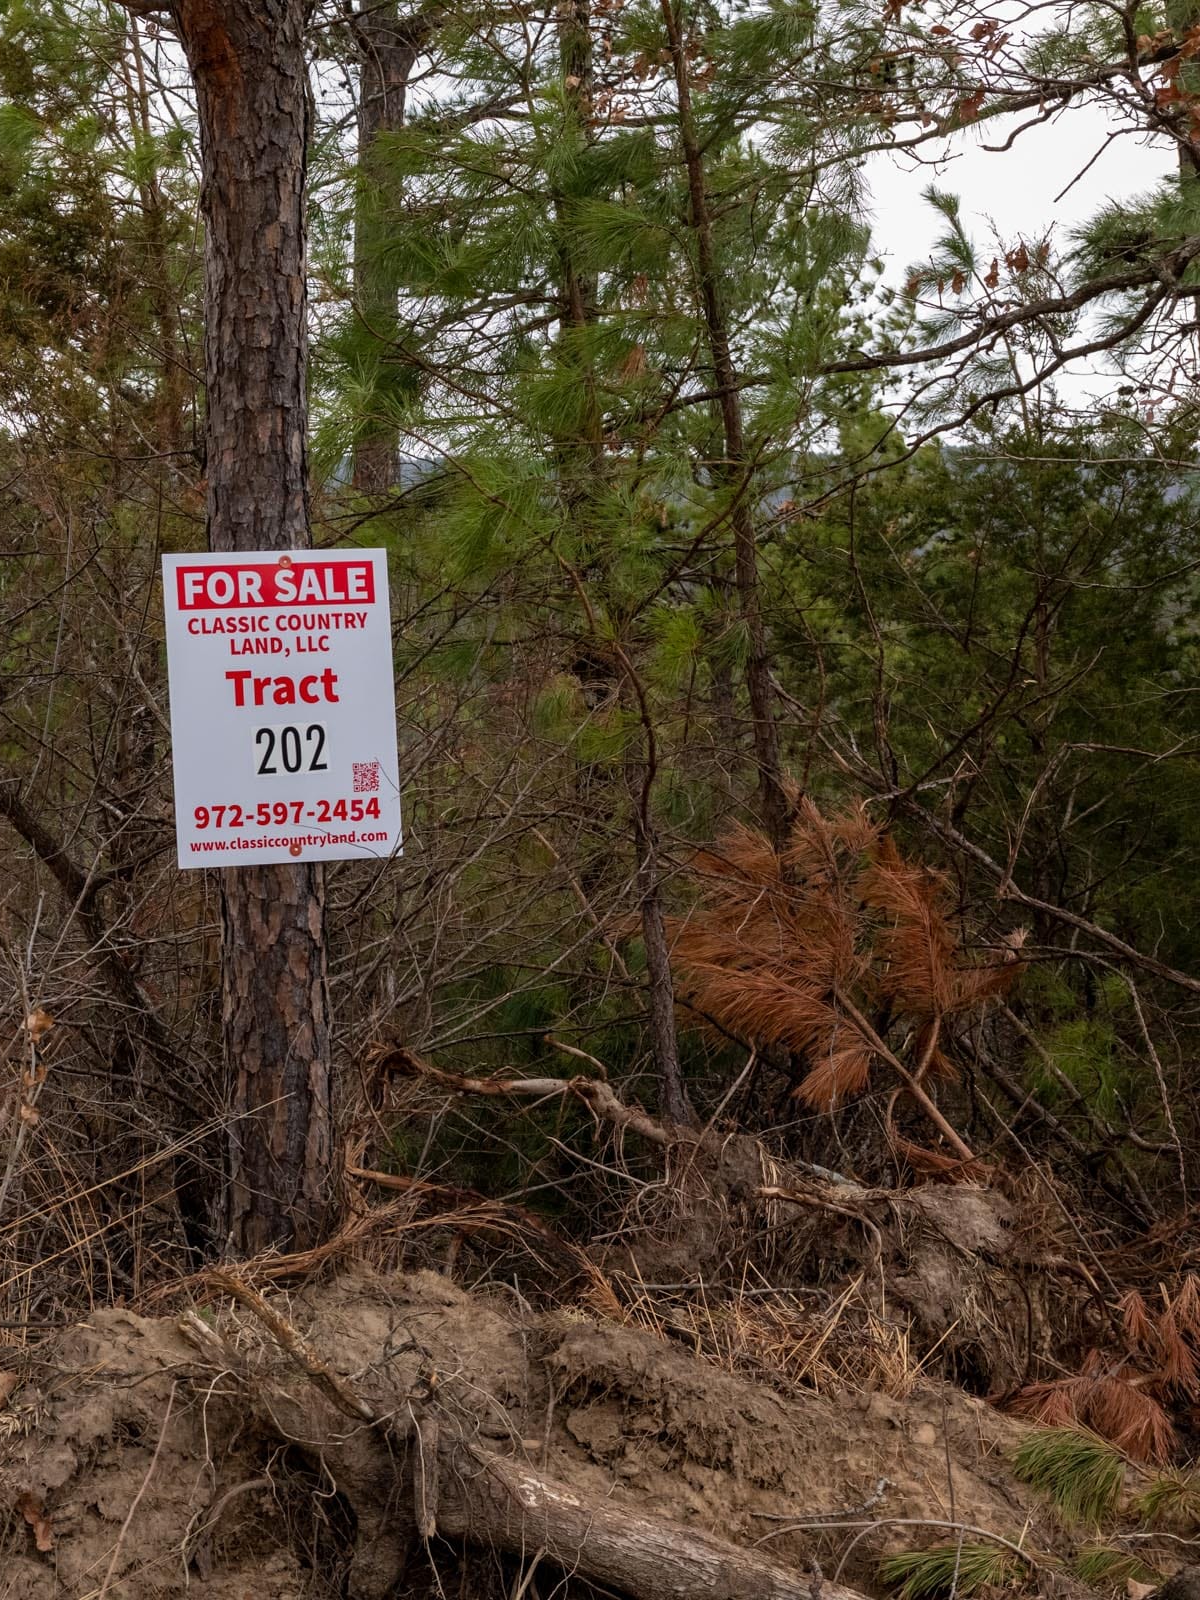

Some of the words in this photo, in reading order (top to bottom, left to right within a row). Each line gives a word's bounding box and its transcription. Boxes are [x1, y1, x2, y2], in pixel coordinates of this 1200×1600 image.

[183, 570, 264, 605] FOR
[274, 567, 368, 603] SALE
[187, 615, 270, 635] CLASSIC
[275, 612, 368, 631] COUNTRY
[230, 637, 290, 657] LAND,
[296, 635, 330, 653] LLC
[225, 668, 339, 706] Tract
[255, 724, 328, 775] 202
[194, 797, 381, 829] 972-597-2454
[190, 831, 388, 852] www.classiccountryland.com
